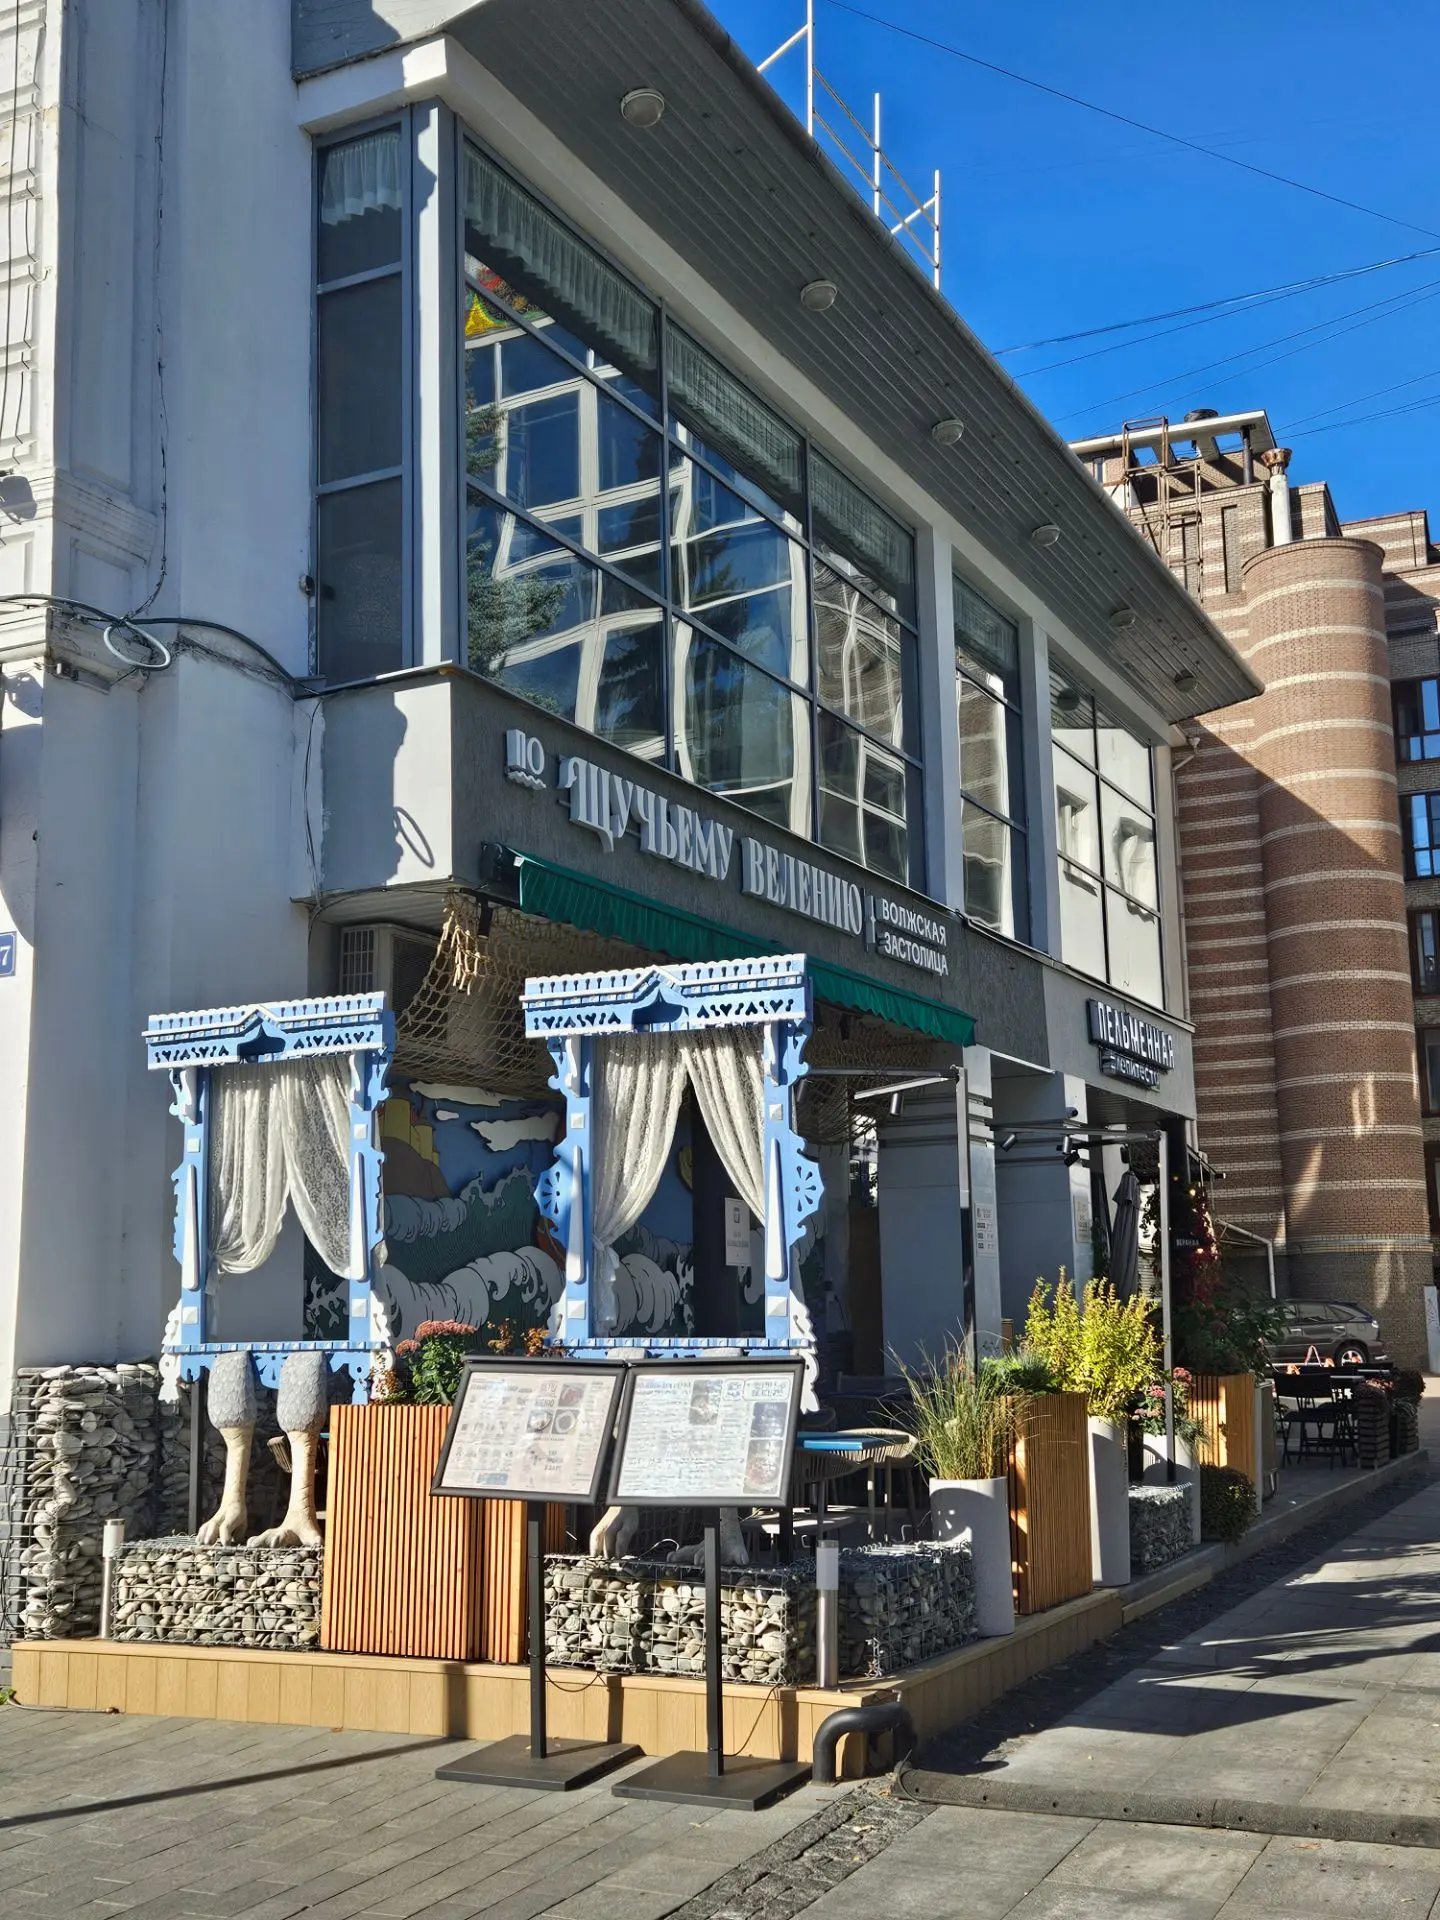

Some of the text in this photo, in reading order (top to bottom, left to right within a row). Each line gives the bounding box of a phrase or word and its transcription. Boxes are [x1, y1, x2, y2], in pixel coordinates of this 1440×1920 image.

[511, 730, 863, 935] ПО ЩУЧЬЕМУ ВЕЛЕНИЮ
[882, 898, 947, 947] ВОЛЖСКАЯ
[884, 931, 949, 976] ЗАСТОЛИЦА
[1097, 1001, 1175, 1070] ПЕЛЬМЕННАЯ
